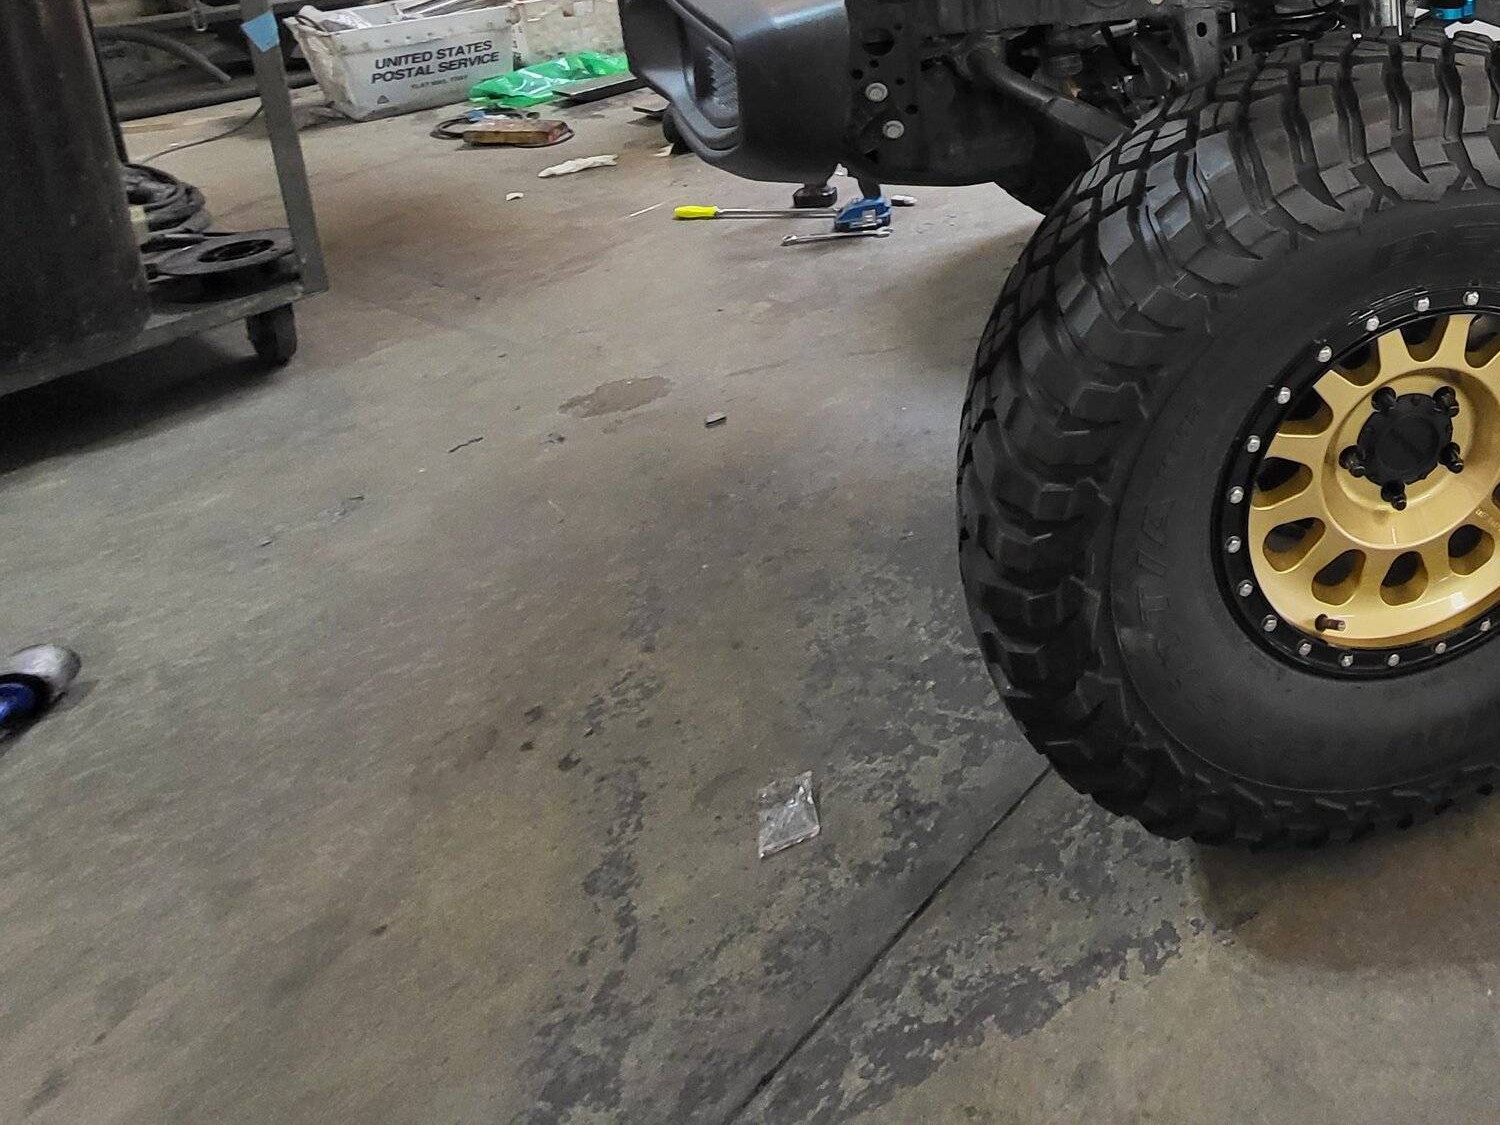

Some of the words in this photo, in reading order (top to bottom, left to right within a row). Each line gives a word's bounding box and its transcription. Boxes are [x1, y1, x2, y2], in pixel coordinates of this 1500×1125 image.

[371, 64, 435, 85] POSTAL
[437, 51, 500, 73] SERVICE
[375, 50, 433, 70] UNITED
[436, 39, 493, 60] STATES
